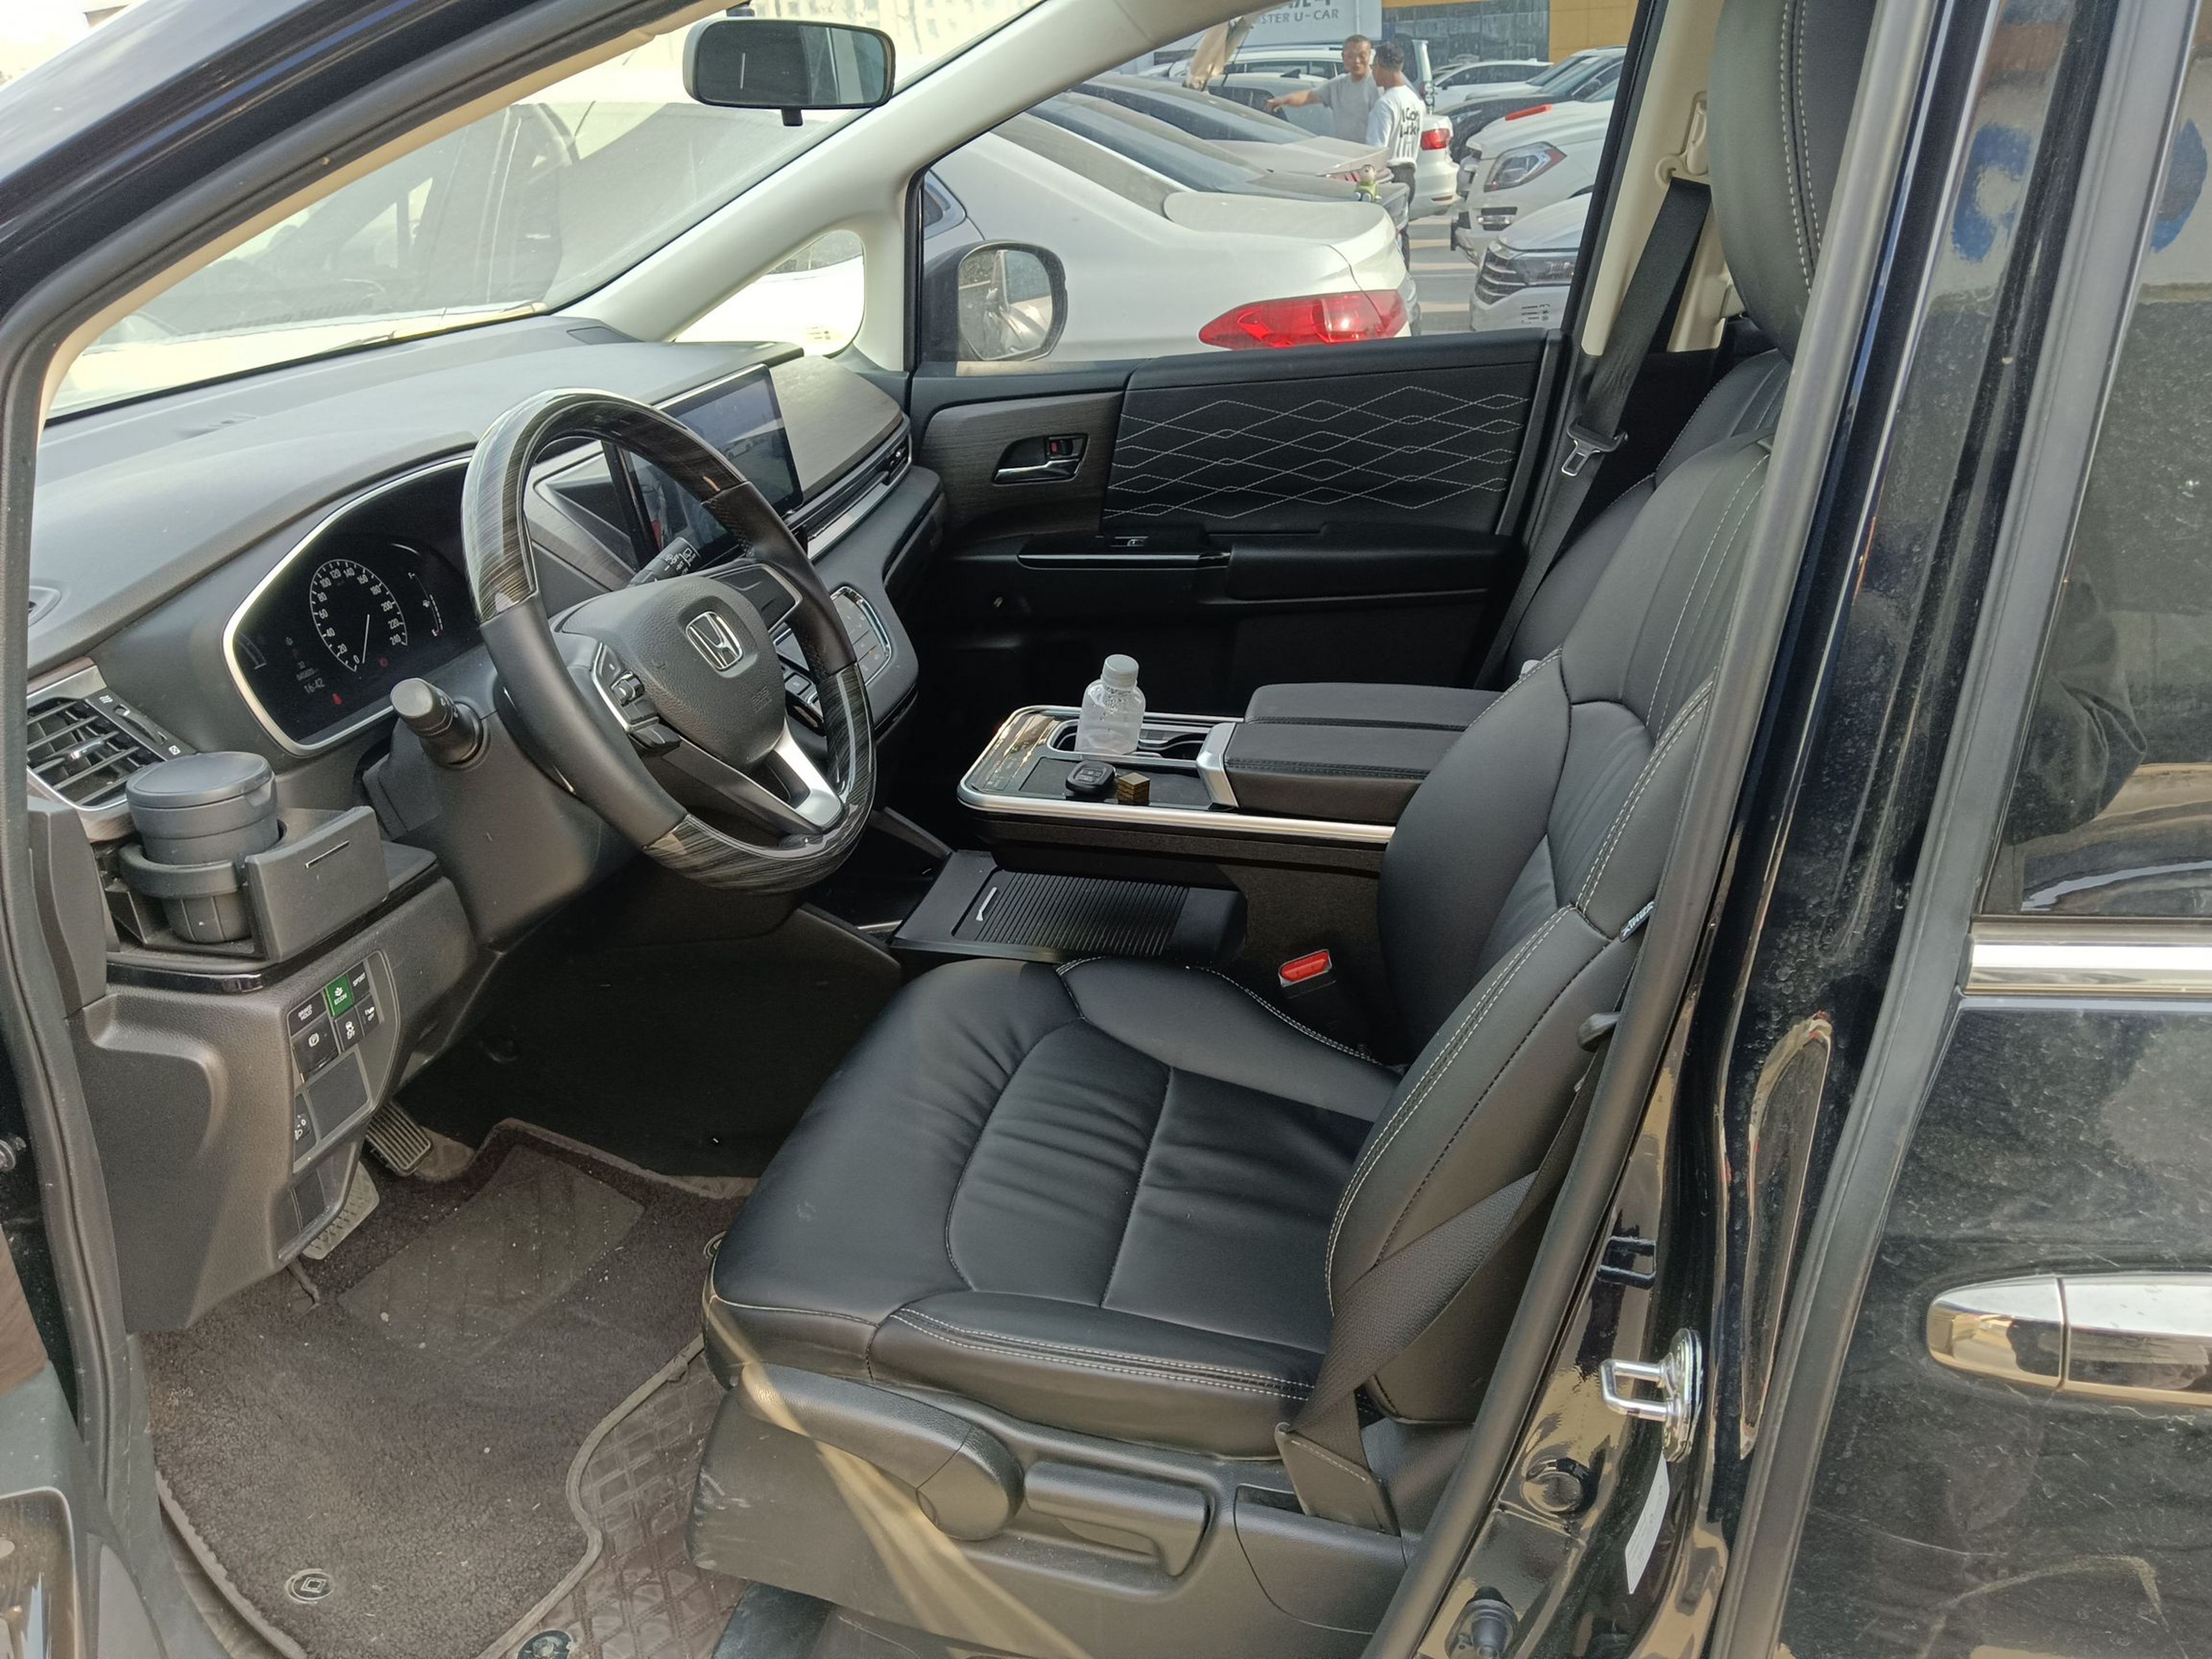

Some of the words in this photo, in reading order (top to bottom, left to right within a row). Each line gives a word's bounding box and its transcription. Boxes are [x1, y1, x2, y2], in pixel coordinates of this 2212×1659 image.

[1294, 9, 1339, 22] U-CAR
[329, 569, 342, 579] 120
[343, 567, 355, 578] 140
[320, 577, 332, 588] 100
[357, 574, 368, 584] 160
[370, 585, 381, 595] 180
[317, 592, 327, 602] 80
[381, 600, 393, 612] 200
[319, 608, 328, 619] 60
[388, 618, 400, 629] 220
[326, 627, 335, 637] 40
[389, 634, 402, 645] 240
[338, 643, 347, 654] 20
[353, 654, 359, 664] 0
[304, 677, 325, 694] 16:42
[352, 972, 365, 987] SPORT
[334, 993, 347, 1005] ECON
